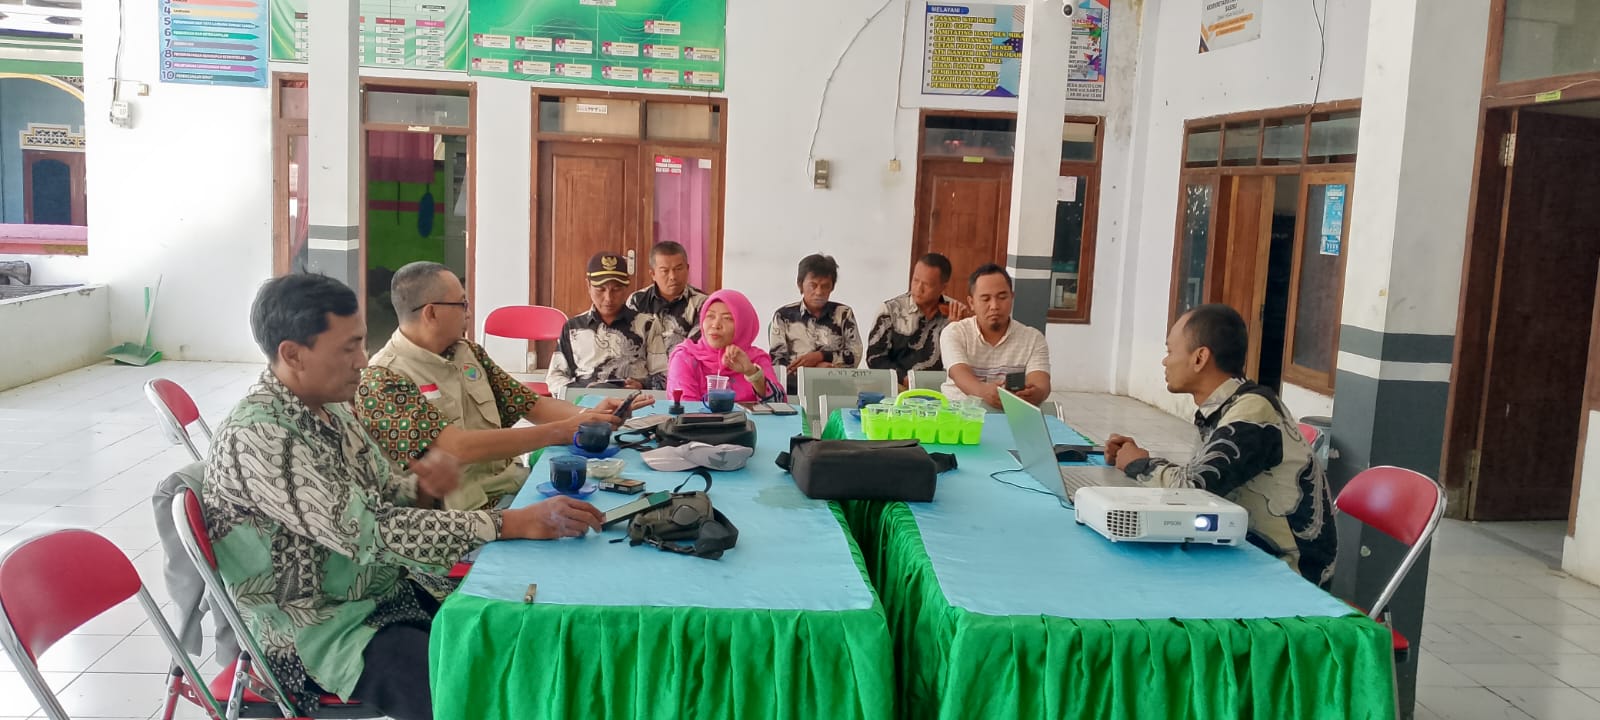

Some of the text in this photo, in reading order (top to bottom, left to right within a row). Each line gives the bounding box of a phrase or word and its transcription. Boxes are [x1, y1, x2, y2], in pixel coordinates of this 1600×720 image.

[164, 7, 171, 15] 4
[164, 17, 171, 26] 5
[164, 28, 172, 37] 6
[165, 39, 171, 47] 7
[164, 50, 172, 58] 8
[165, 61, 172, 69] 9
[162, 71, 175, 80] 10
